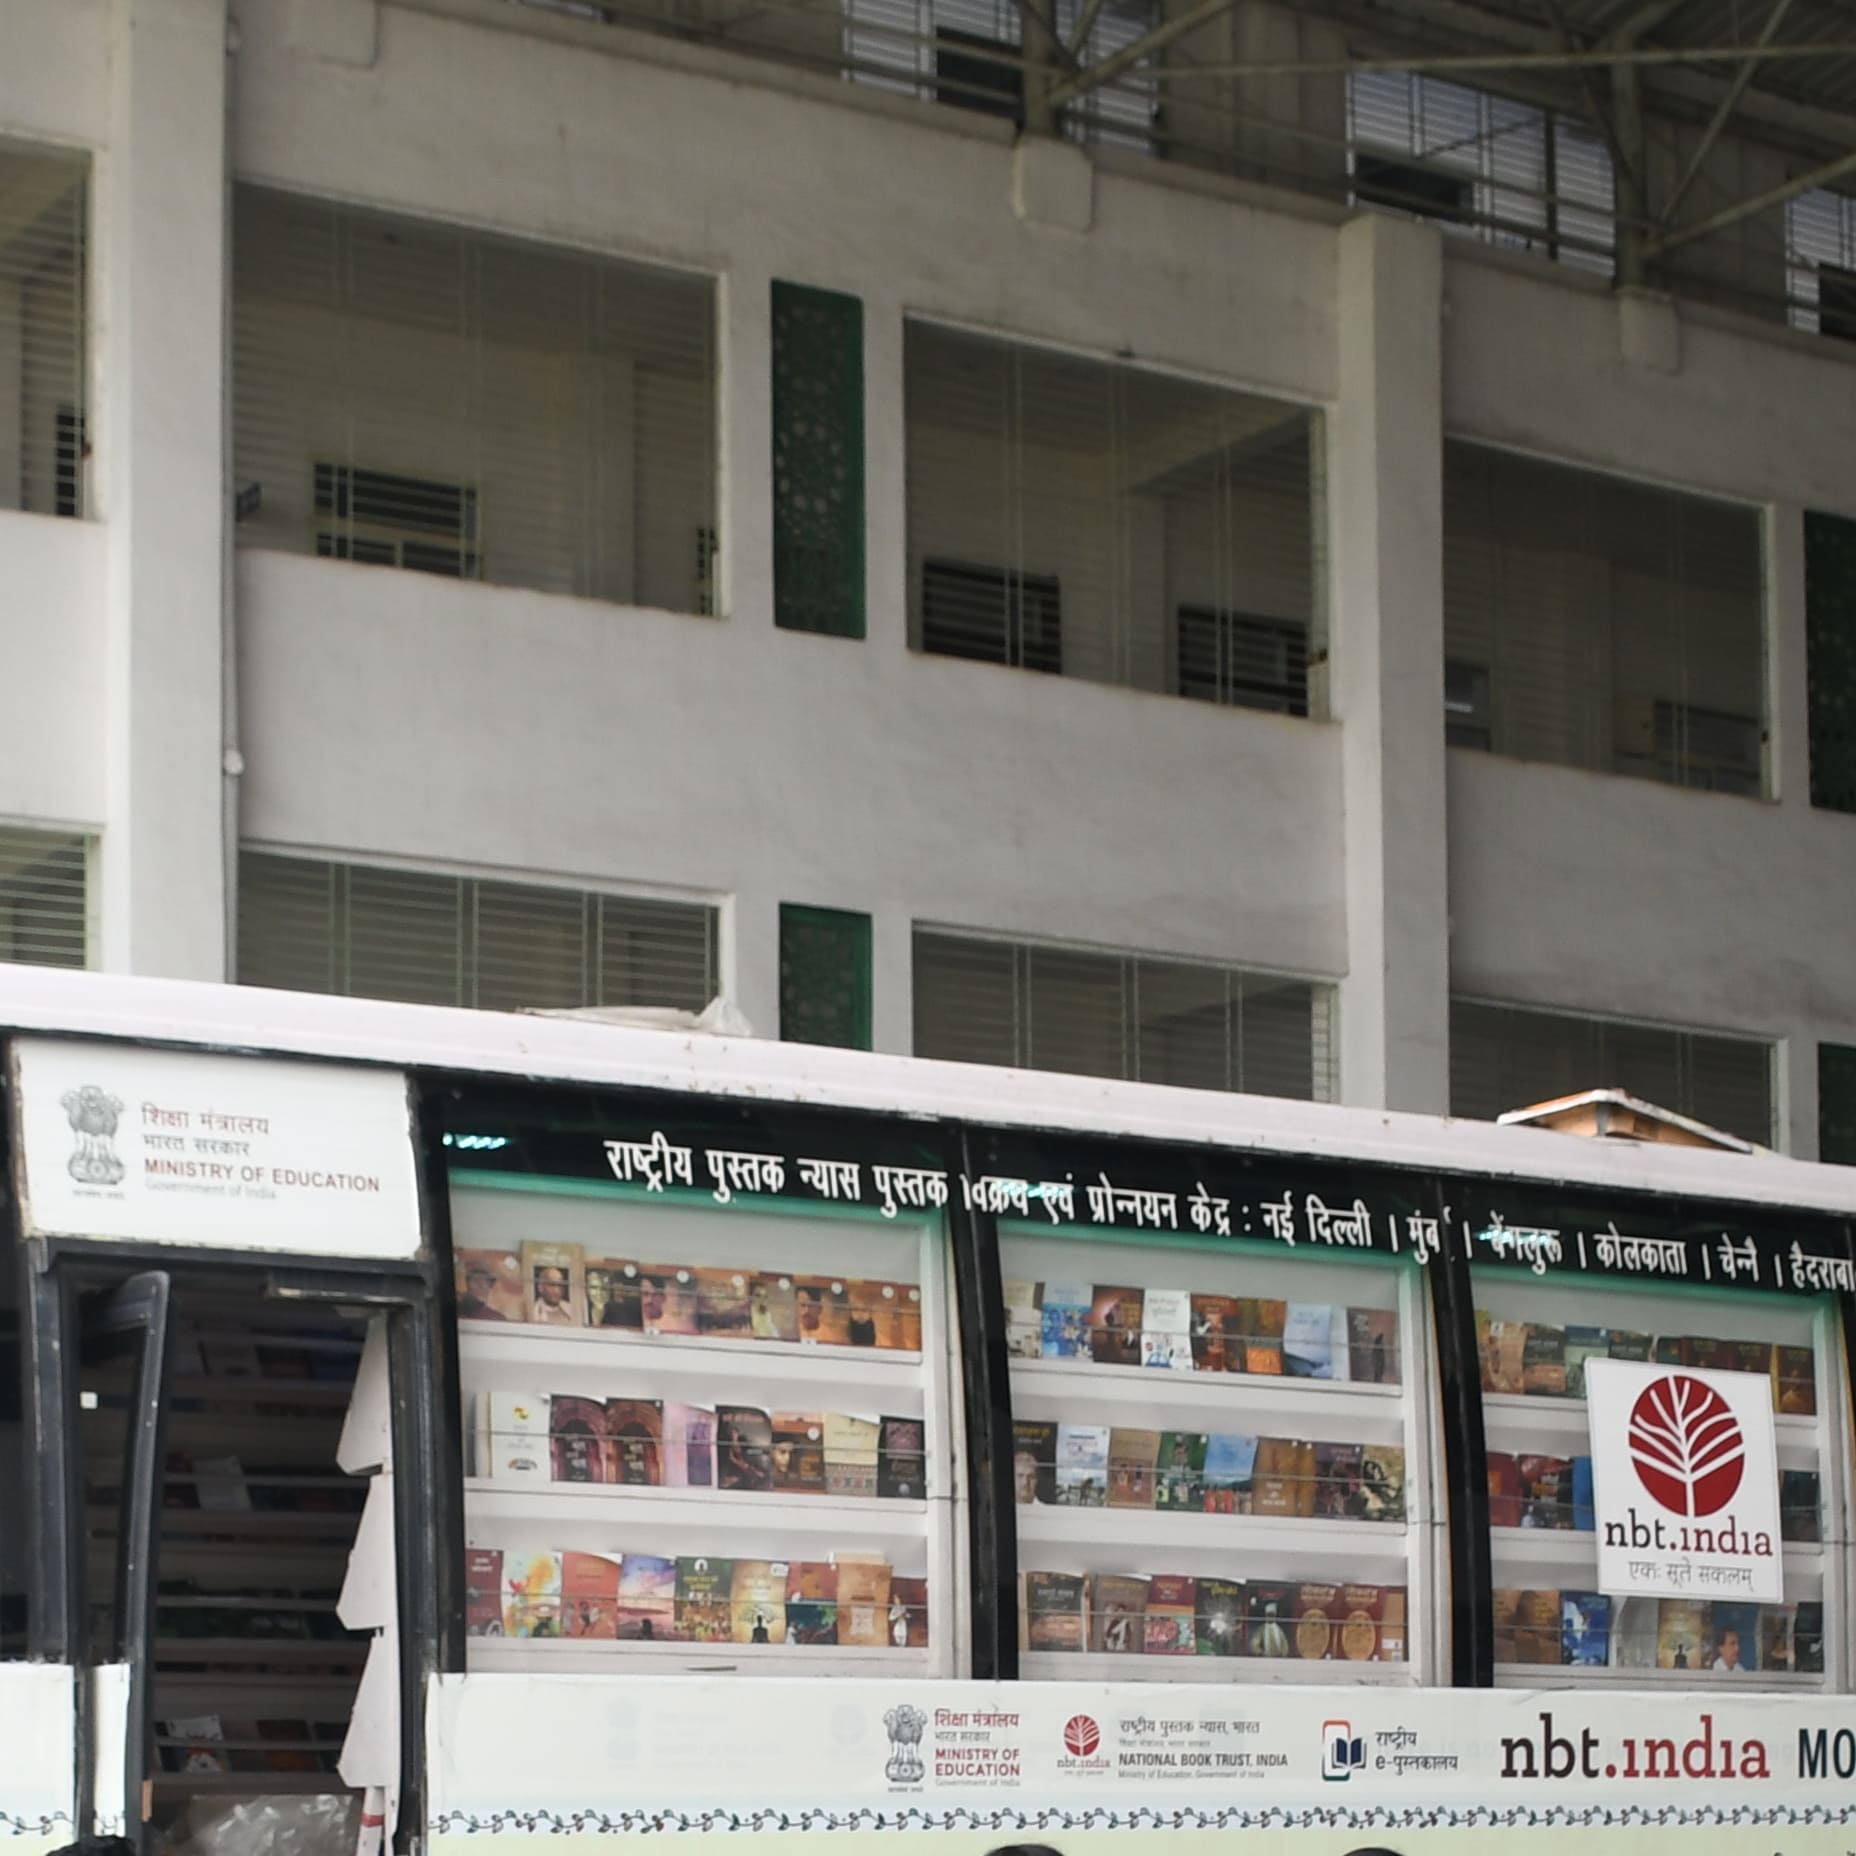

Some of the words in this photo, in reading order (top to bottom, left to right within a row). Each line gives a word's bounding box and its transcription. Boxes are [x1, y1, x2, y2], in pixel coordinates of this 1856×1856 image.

[141, 1102, 190, 1129] शिक्षा
[199, 1107, 270, 1135] मंत्रालय
[143, 1134, 185, 1151] भारत
[193, 1138, 251, 1157] सरकार
[144, 1158, 233, 1181] MINISTRY
[240, 1165, 265, 1183] OF
[271, 1168, 381, 1193] EDUCATION
[603, 1131, 693, 1193] राष्ट्रीय
[705, 1149, 785, 1204] पुस्तक
[796, 1157, 860, 1201] न्यास
[872, 1165, 949, 1219] पुस्तक
[1086, 1171, 1179, 1230] प्रोन्नयन
[1260, 1190, 1296, 1247] नई
[1305, 1193, 1373, 1247] दिल्ली
[1406, 1205, 1452, 1265] मुंब
[1593, 1221, 1688, 1276] कोलकाता
[1605, 1508, 1773, 1556] nbt.india
[934, 1708, 968, 1727] शिक्षा
[973, 1709, 1020, 1728] मंत्रालय
[1120, 1716, 1156, 1735] राष्ट्रीय
[1160, 1720, 1194, 1737] पुस्तक
[1233, 1721, 1260, 1734] भारत
[935, 1731, 957, 1742] भारत
[1375, 1727, 1417, 1750] राष्ट्रीय
[1501, 1712, 1771, 1778] nbt.india
[935, 1749, 997, 1761] MINISTRY
[1002, 1749, 1020, 1761] OF
[1119, 1754, 1177, 1766] NATIONAL
[1181, 1754, 1212, 1766] BOOK
[1216, 1754, 1253, 1767] TRUST,
[1256, 1754, 1288, 1766] INDIA
[1375, 1755, 1458, 1775] e-पुस्तकालय
[935, 1764, 1021, 1777] EDUCATION
